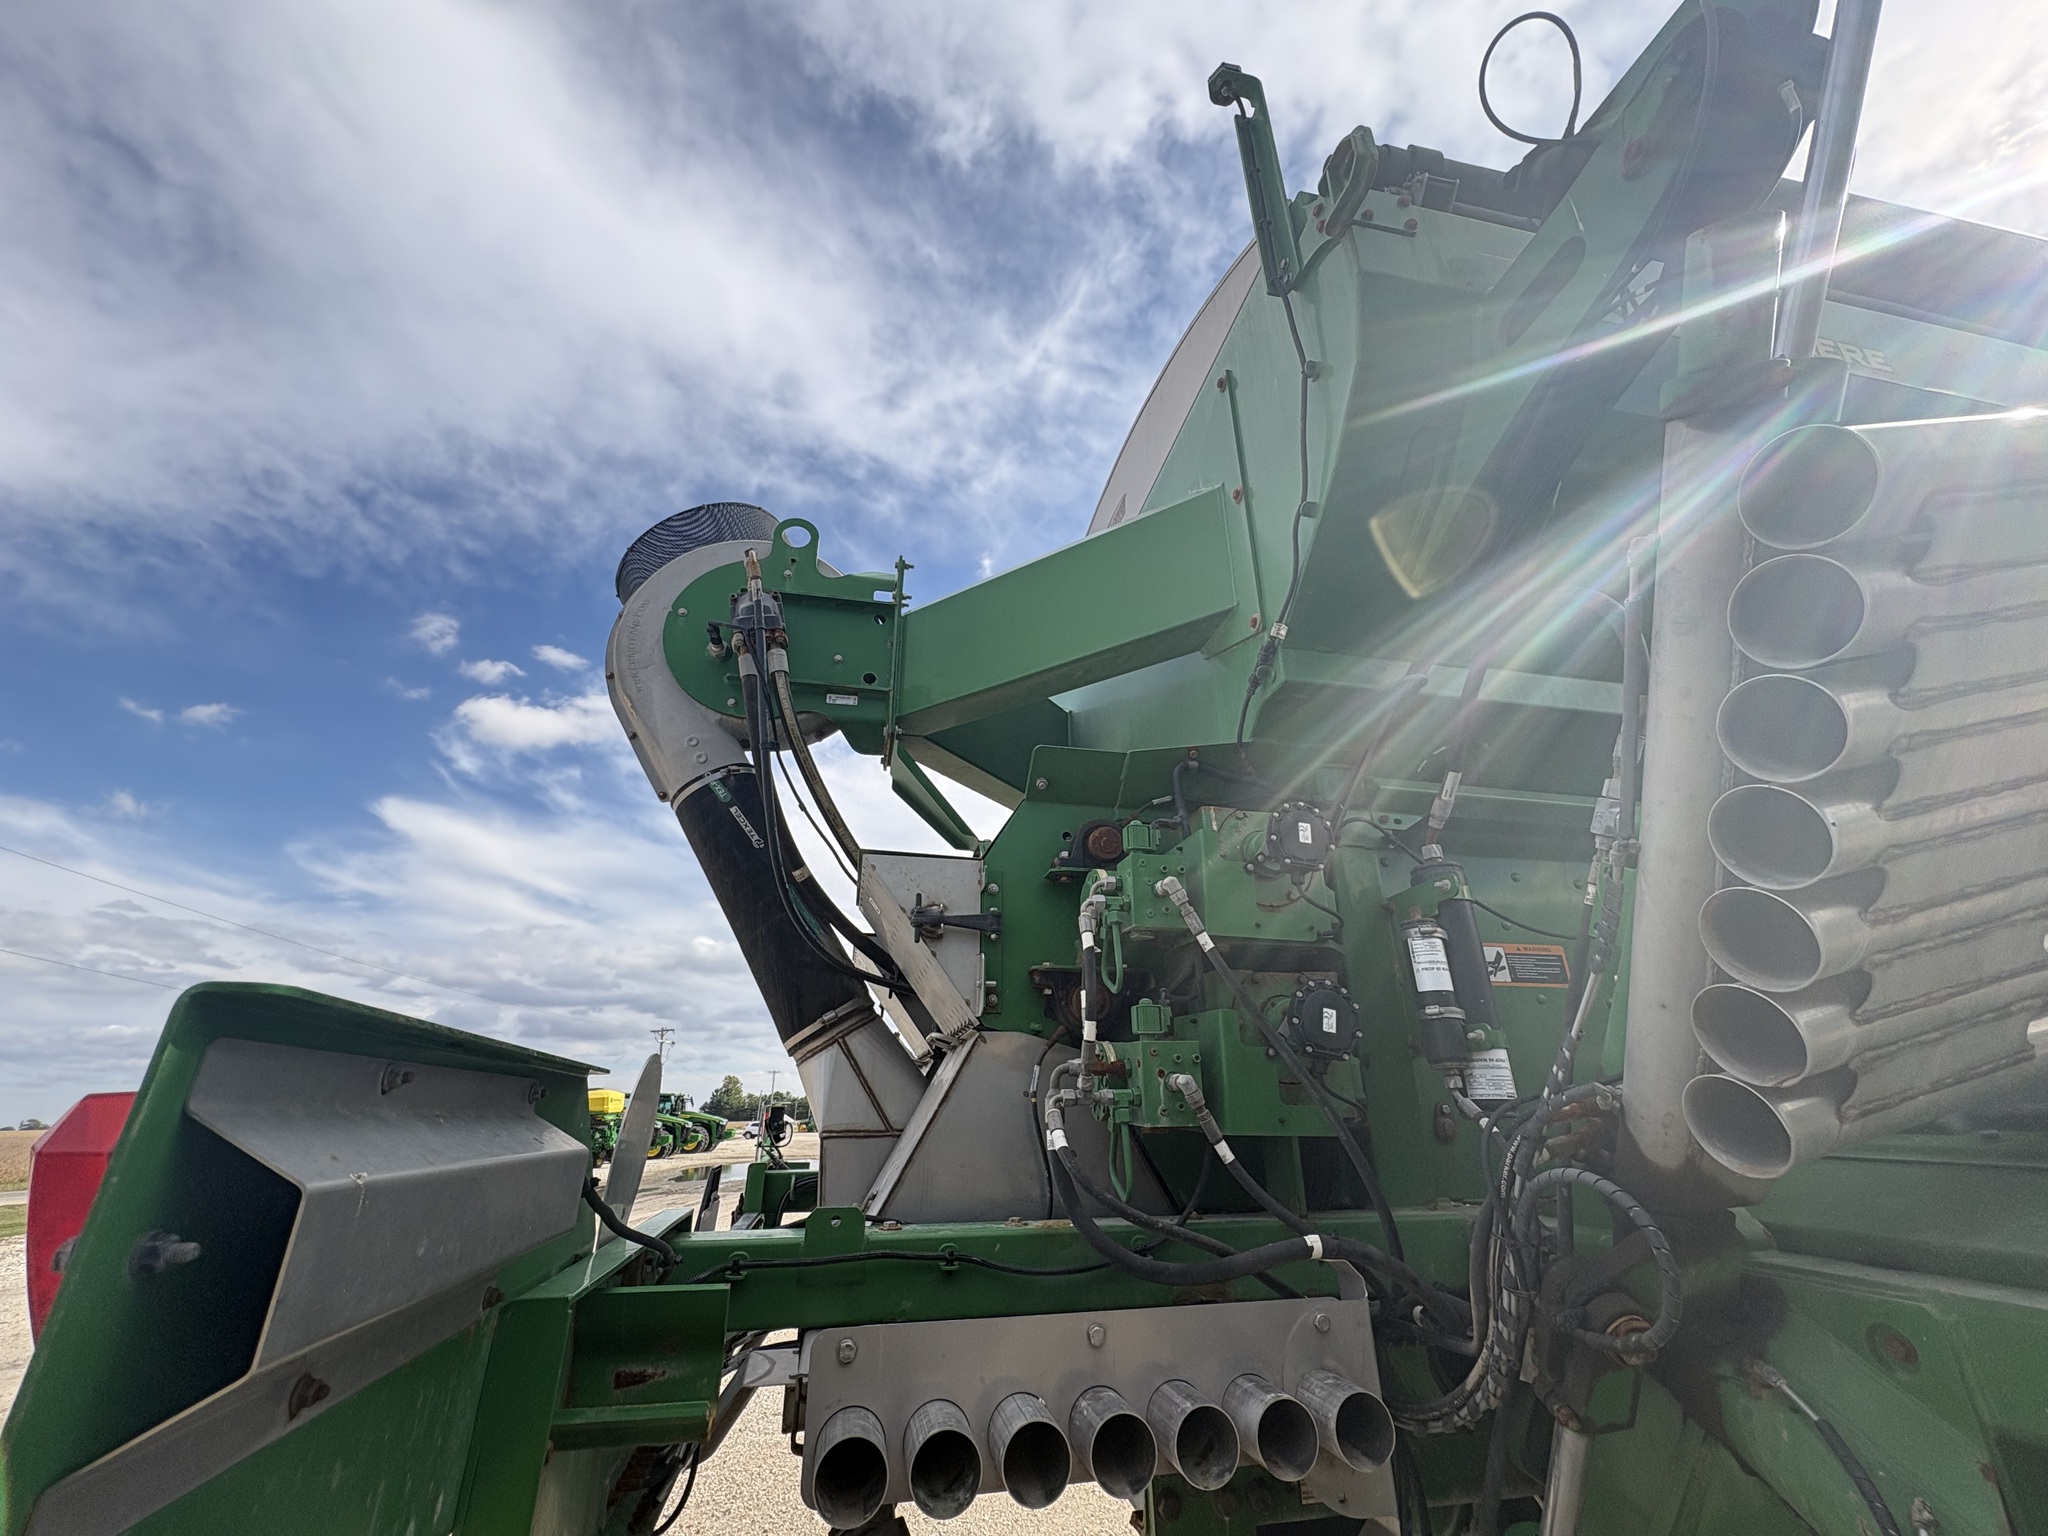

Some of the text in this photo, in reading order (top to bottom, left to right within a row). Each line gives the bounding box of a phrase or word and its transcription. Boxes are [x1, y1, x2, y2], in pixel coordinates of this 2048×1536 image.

[1814, 337, 1894, 372] ERE
[733, 808, 756, 841] TEXCEL
[1500, 1134, 1521, 1198] www.parker.com
